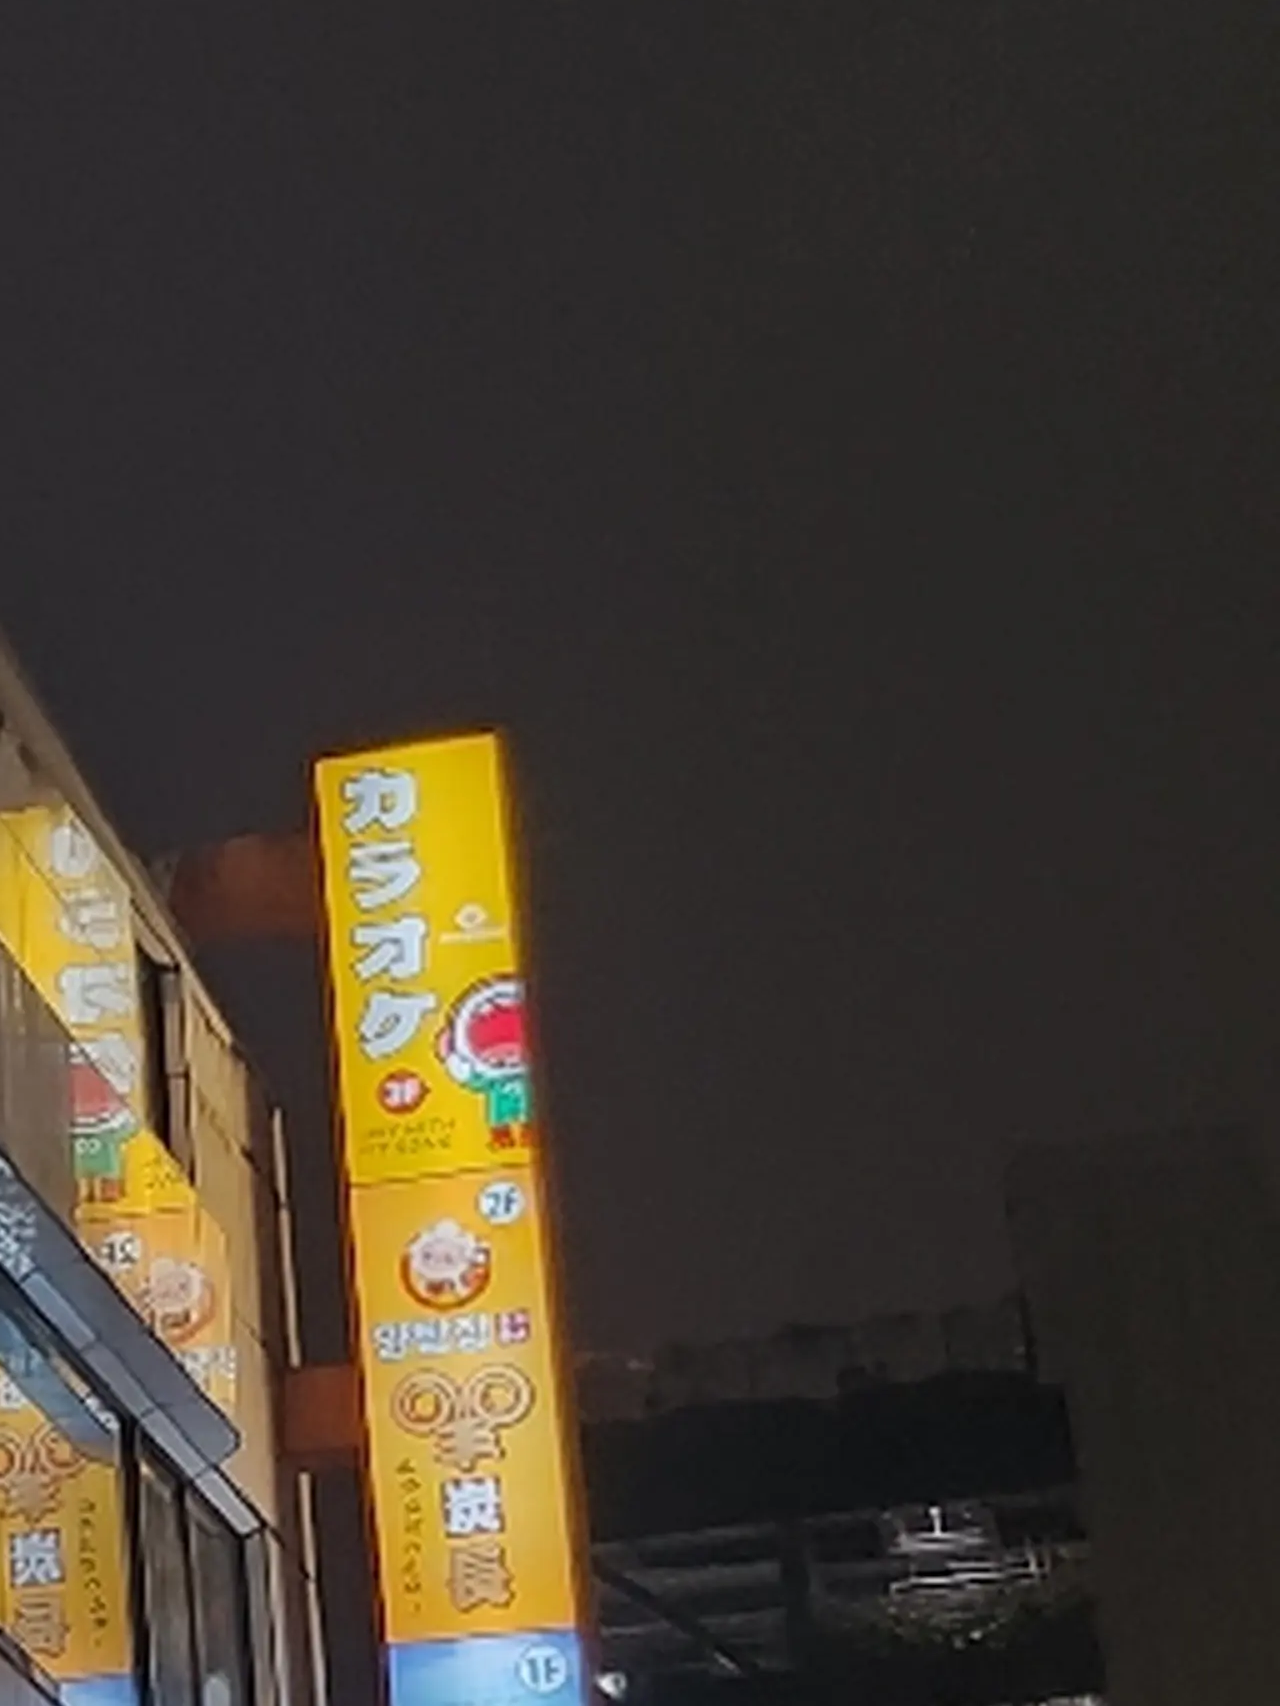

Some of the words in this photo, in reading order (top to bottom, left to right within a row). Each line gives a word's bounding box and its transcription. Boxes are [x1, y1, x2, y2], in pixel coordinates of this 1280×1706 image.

[340, 769, 438, 1061] カラオケ
[484, 1185, 520, 1219] 2F
